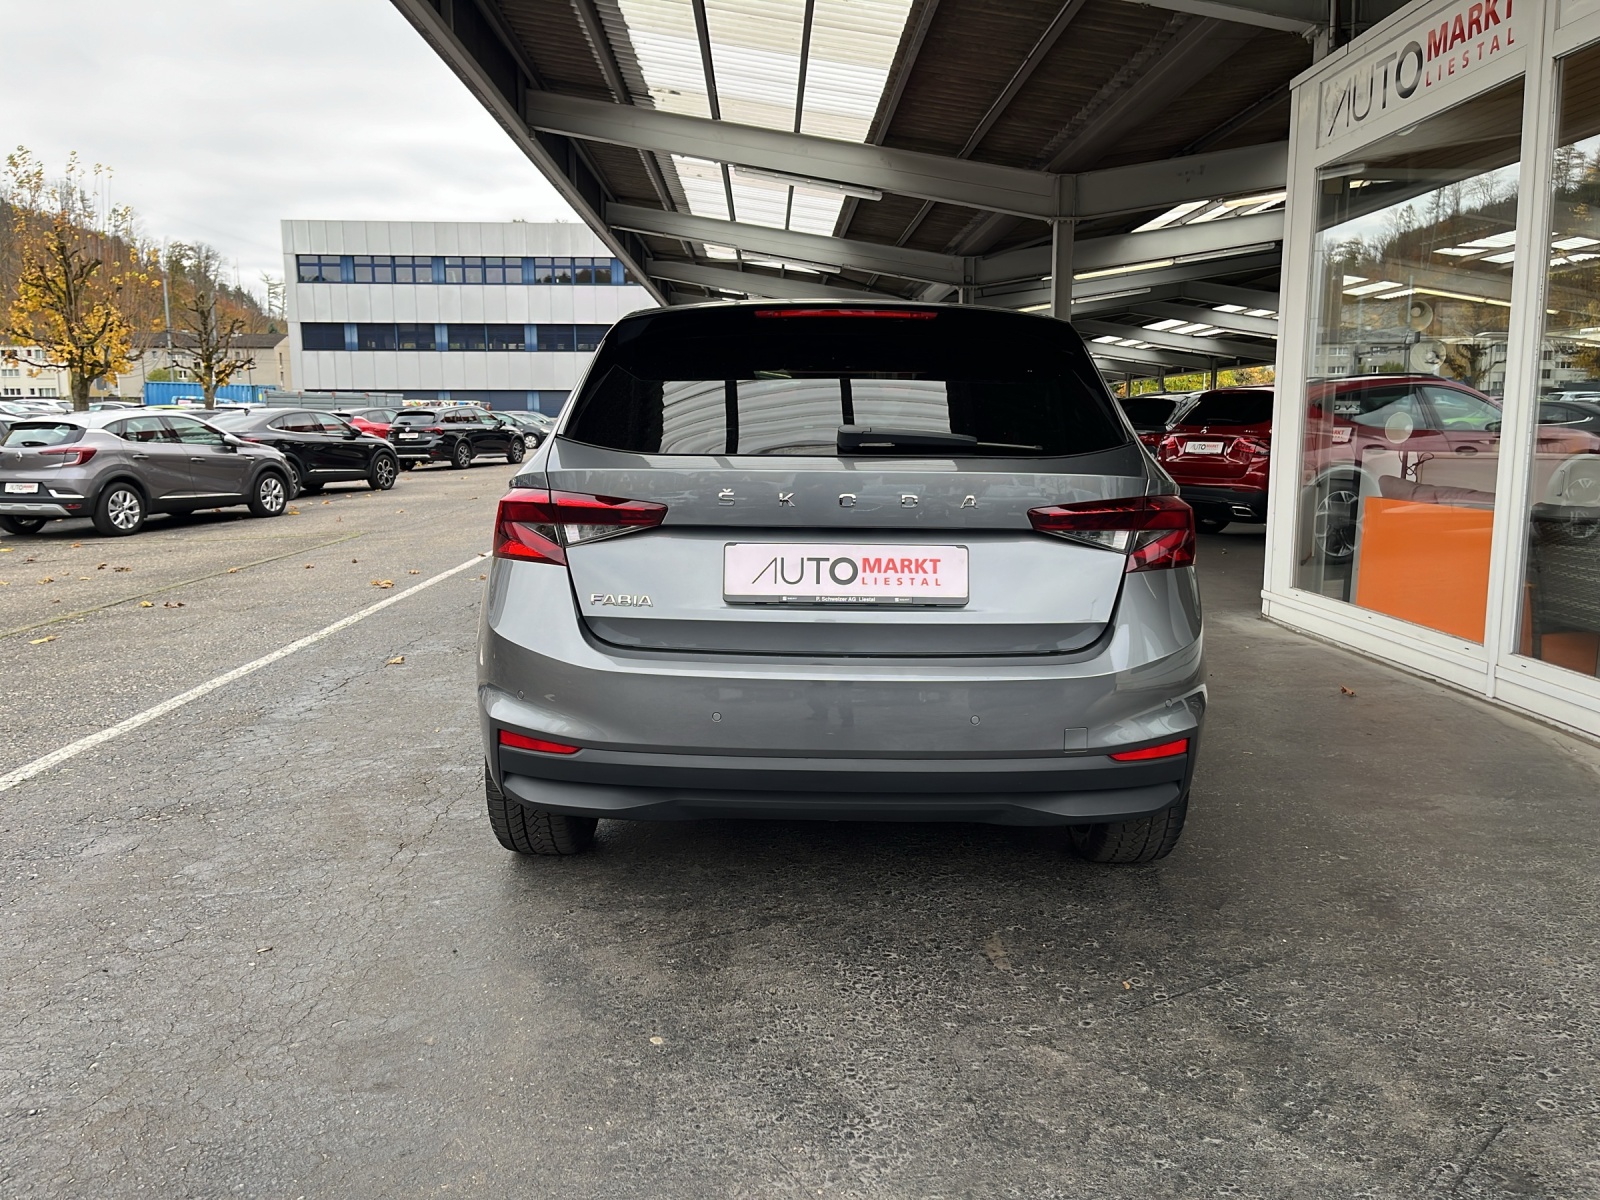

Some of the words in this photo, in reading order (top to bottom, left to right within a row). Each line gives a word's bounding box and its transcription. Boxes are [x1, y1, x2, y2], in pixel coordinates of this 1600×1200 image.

[1425, 27, 1515, 87] LIESTAL
[1328, 40, 1424, 137] AUTO
[718, 488, 979, 510] ŠKODA
[752, 557, 858, 586] AUTO
[862, 557, 941, 575] MARKT
[862, 577, 941, 587] LIESTAL
[590, 593, 654, 608] FABIA
